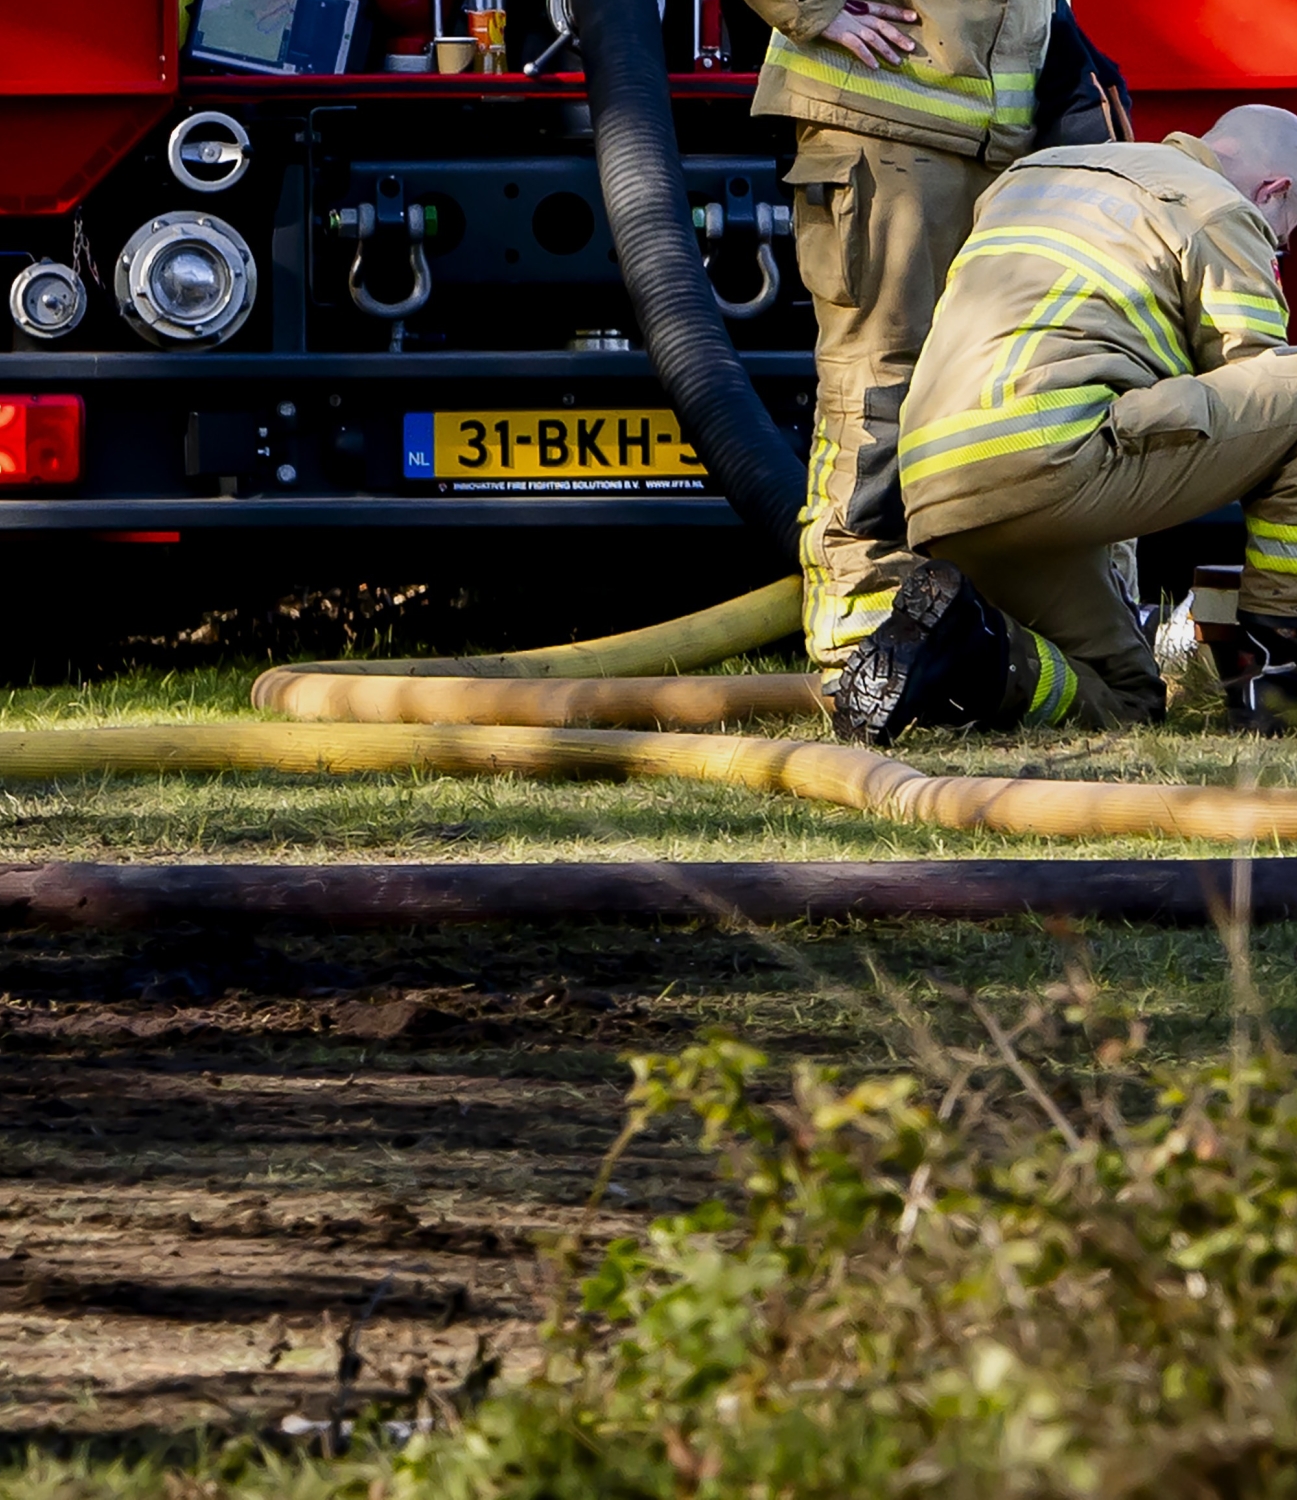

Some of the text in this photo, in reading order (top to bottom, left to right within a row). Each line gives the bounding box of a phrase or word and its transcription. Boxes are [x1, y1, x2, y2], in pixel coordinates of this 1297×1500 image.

[408, 451, 430, 467] NL
[453, 481, 505, 491] INNOVATIVE
[507, 481, 527, 490] FIRE
[528, 480, 571, 490] FIGHTING
[572, 480, 623, 490] SOLUTIONS
